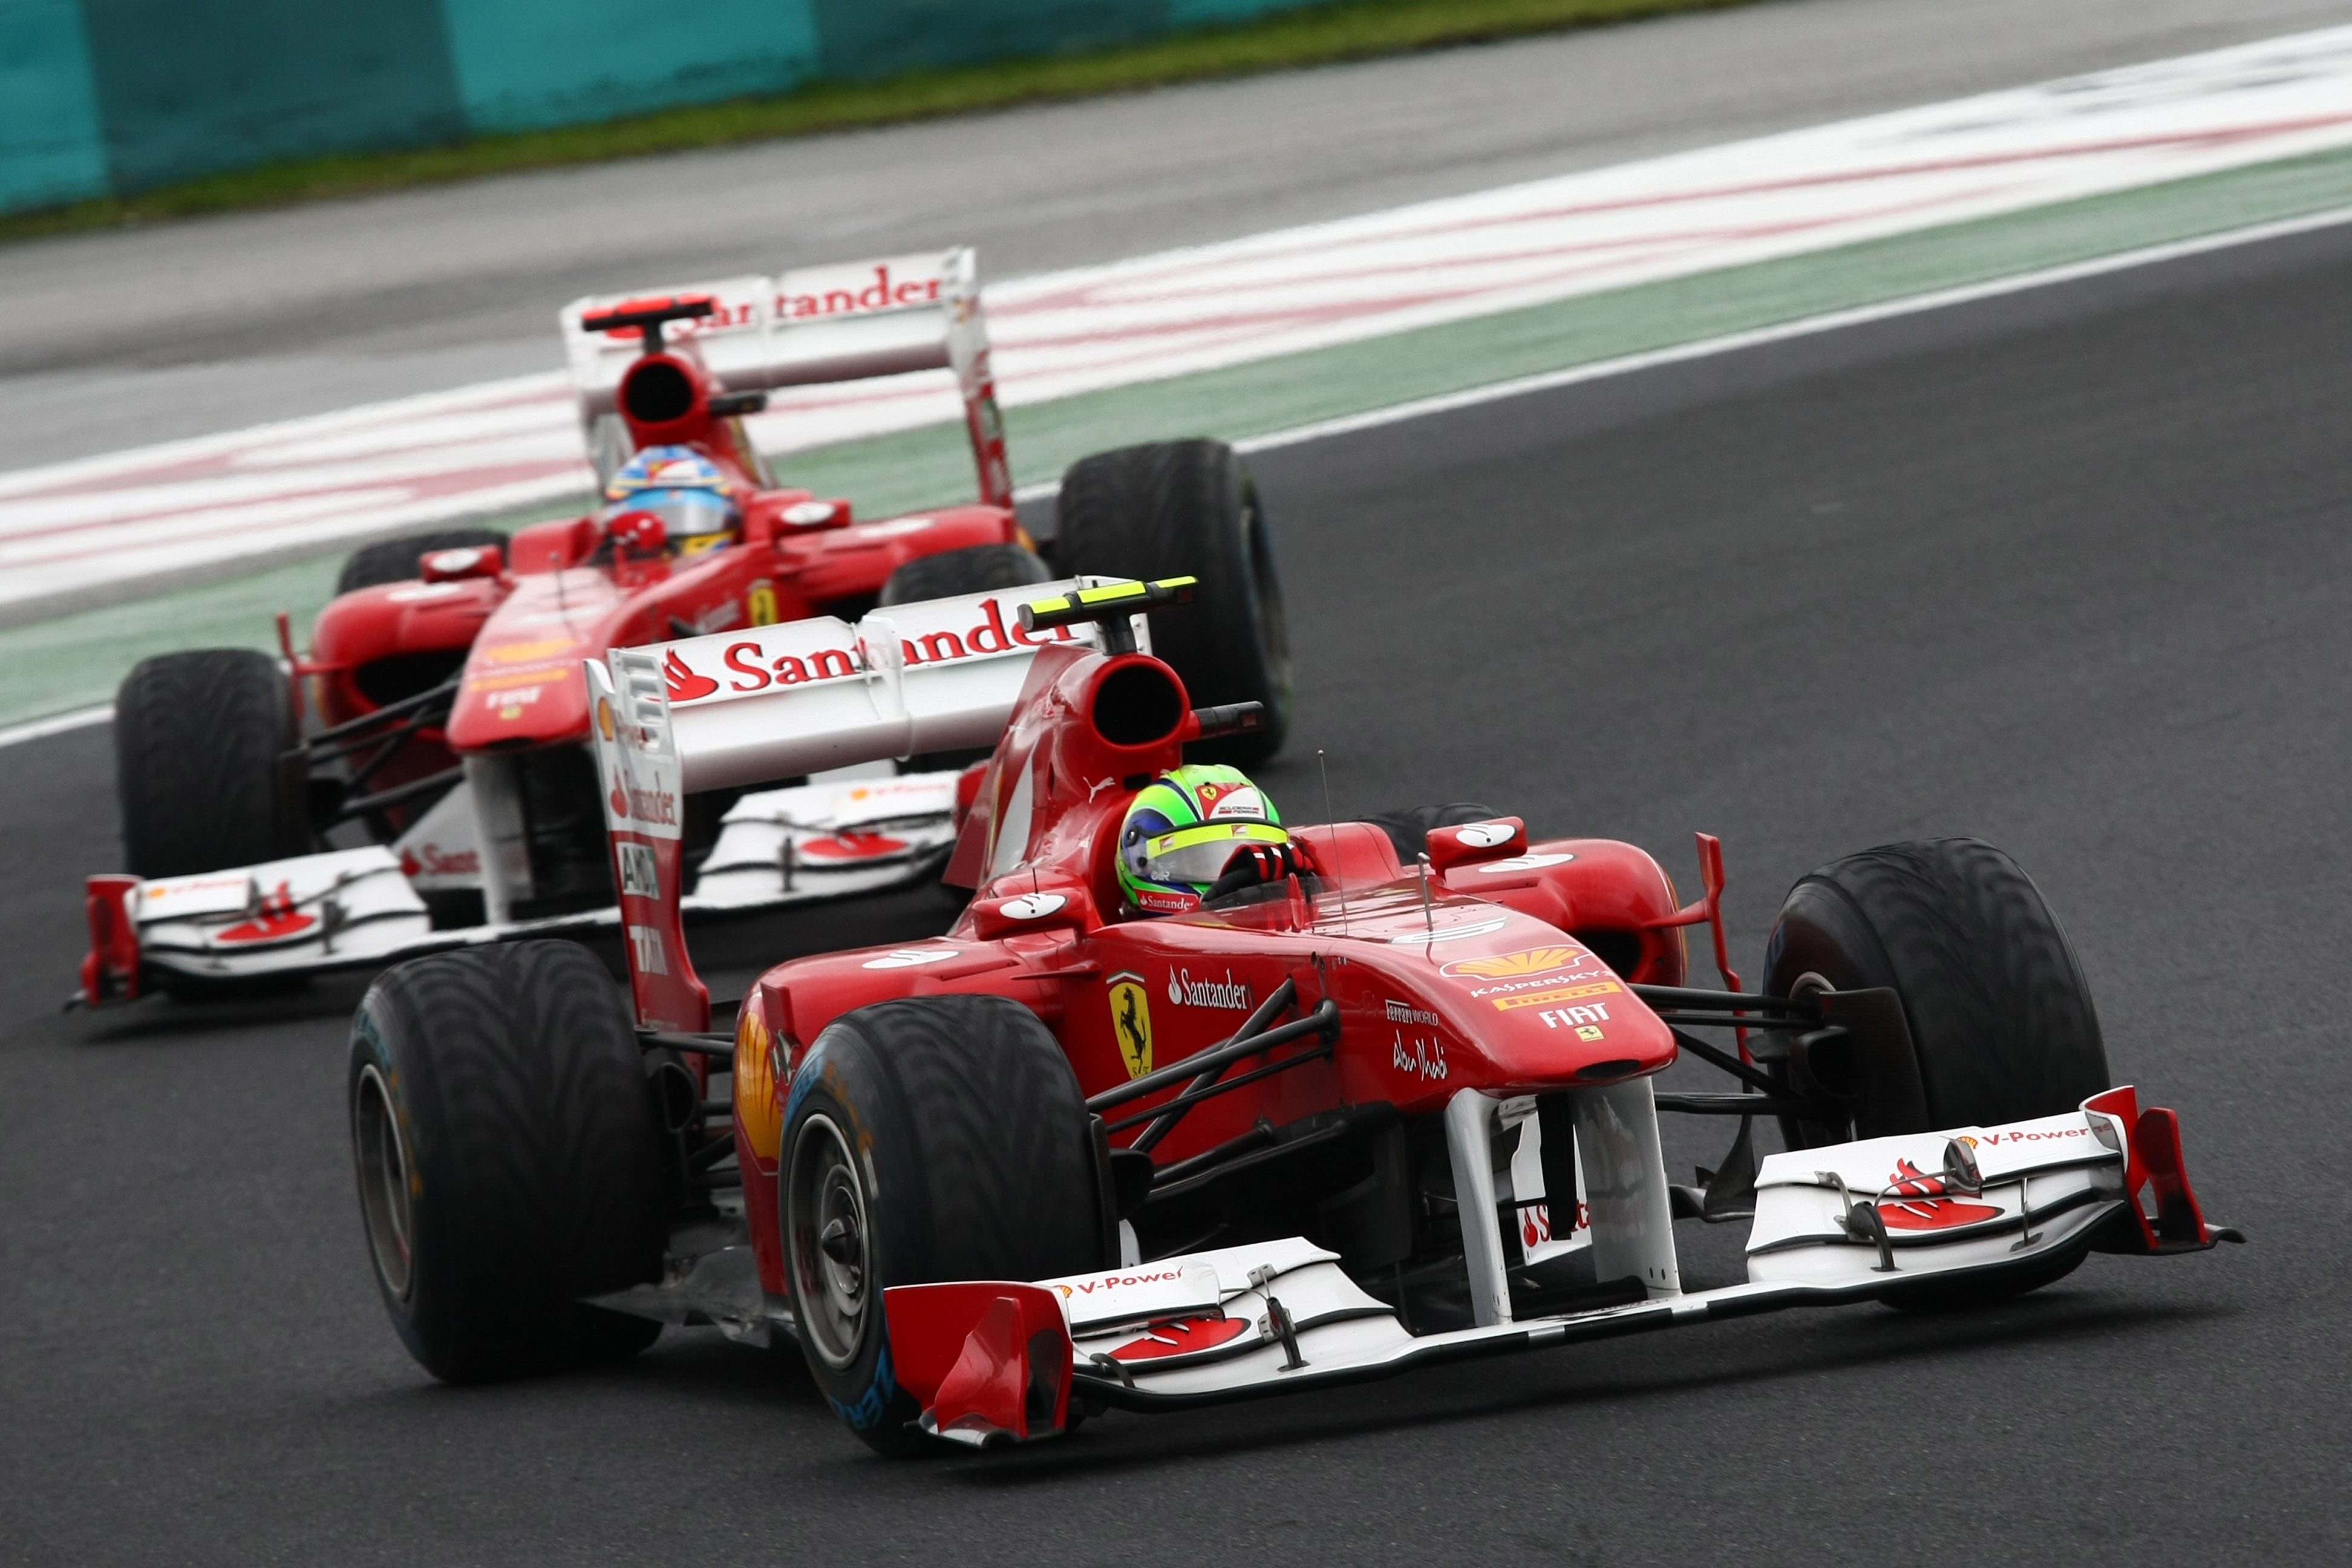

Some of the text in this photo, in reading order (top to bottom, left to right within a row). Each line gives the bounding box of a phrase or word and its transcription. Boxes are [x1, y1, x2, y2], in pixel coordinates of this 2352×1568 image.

[1181, 967, 1247, 1010] Santander
[1470, 970, 1600, 998] KASPERSKY
[1412, 1008, 1439, 1027] WORLD
[1538, 1002, 1610, 1029] FIAT
[1981, 1127, 2089, 1146] V-Power
[1077, 1265, 1184, 1295] V-Power
